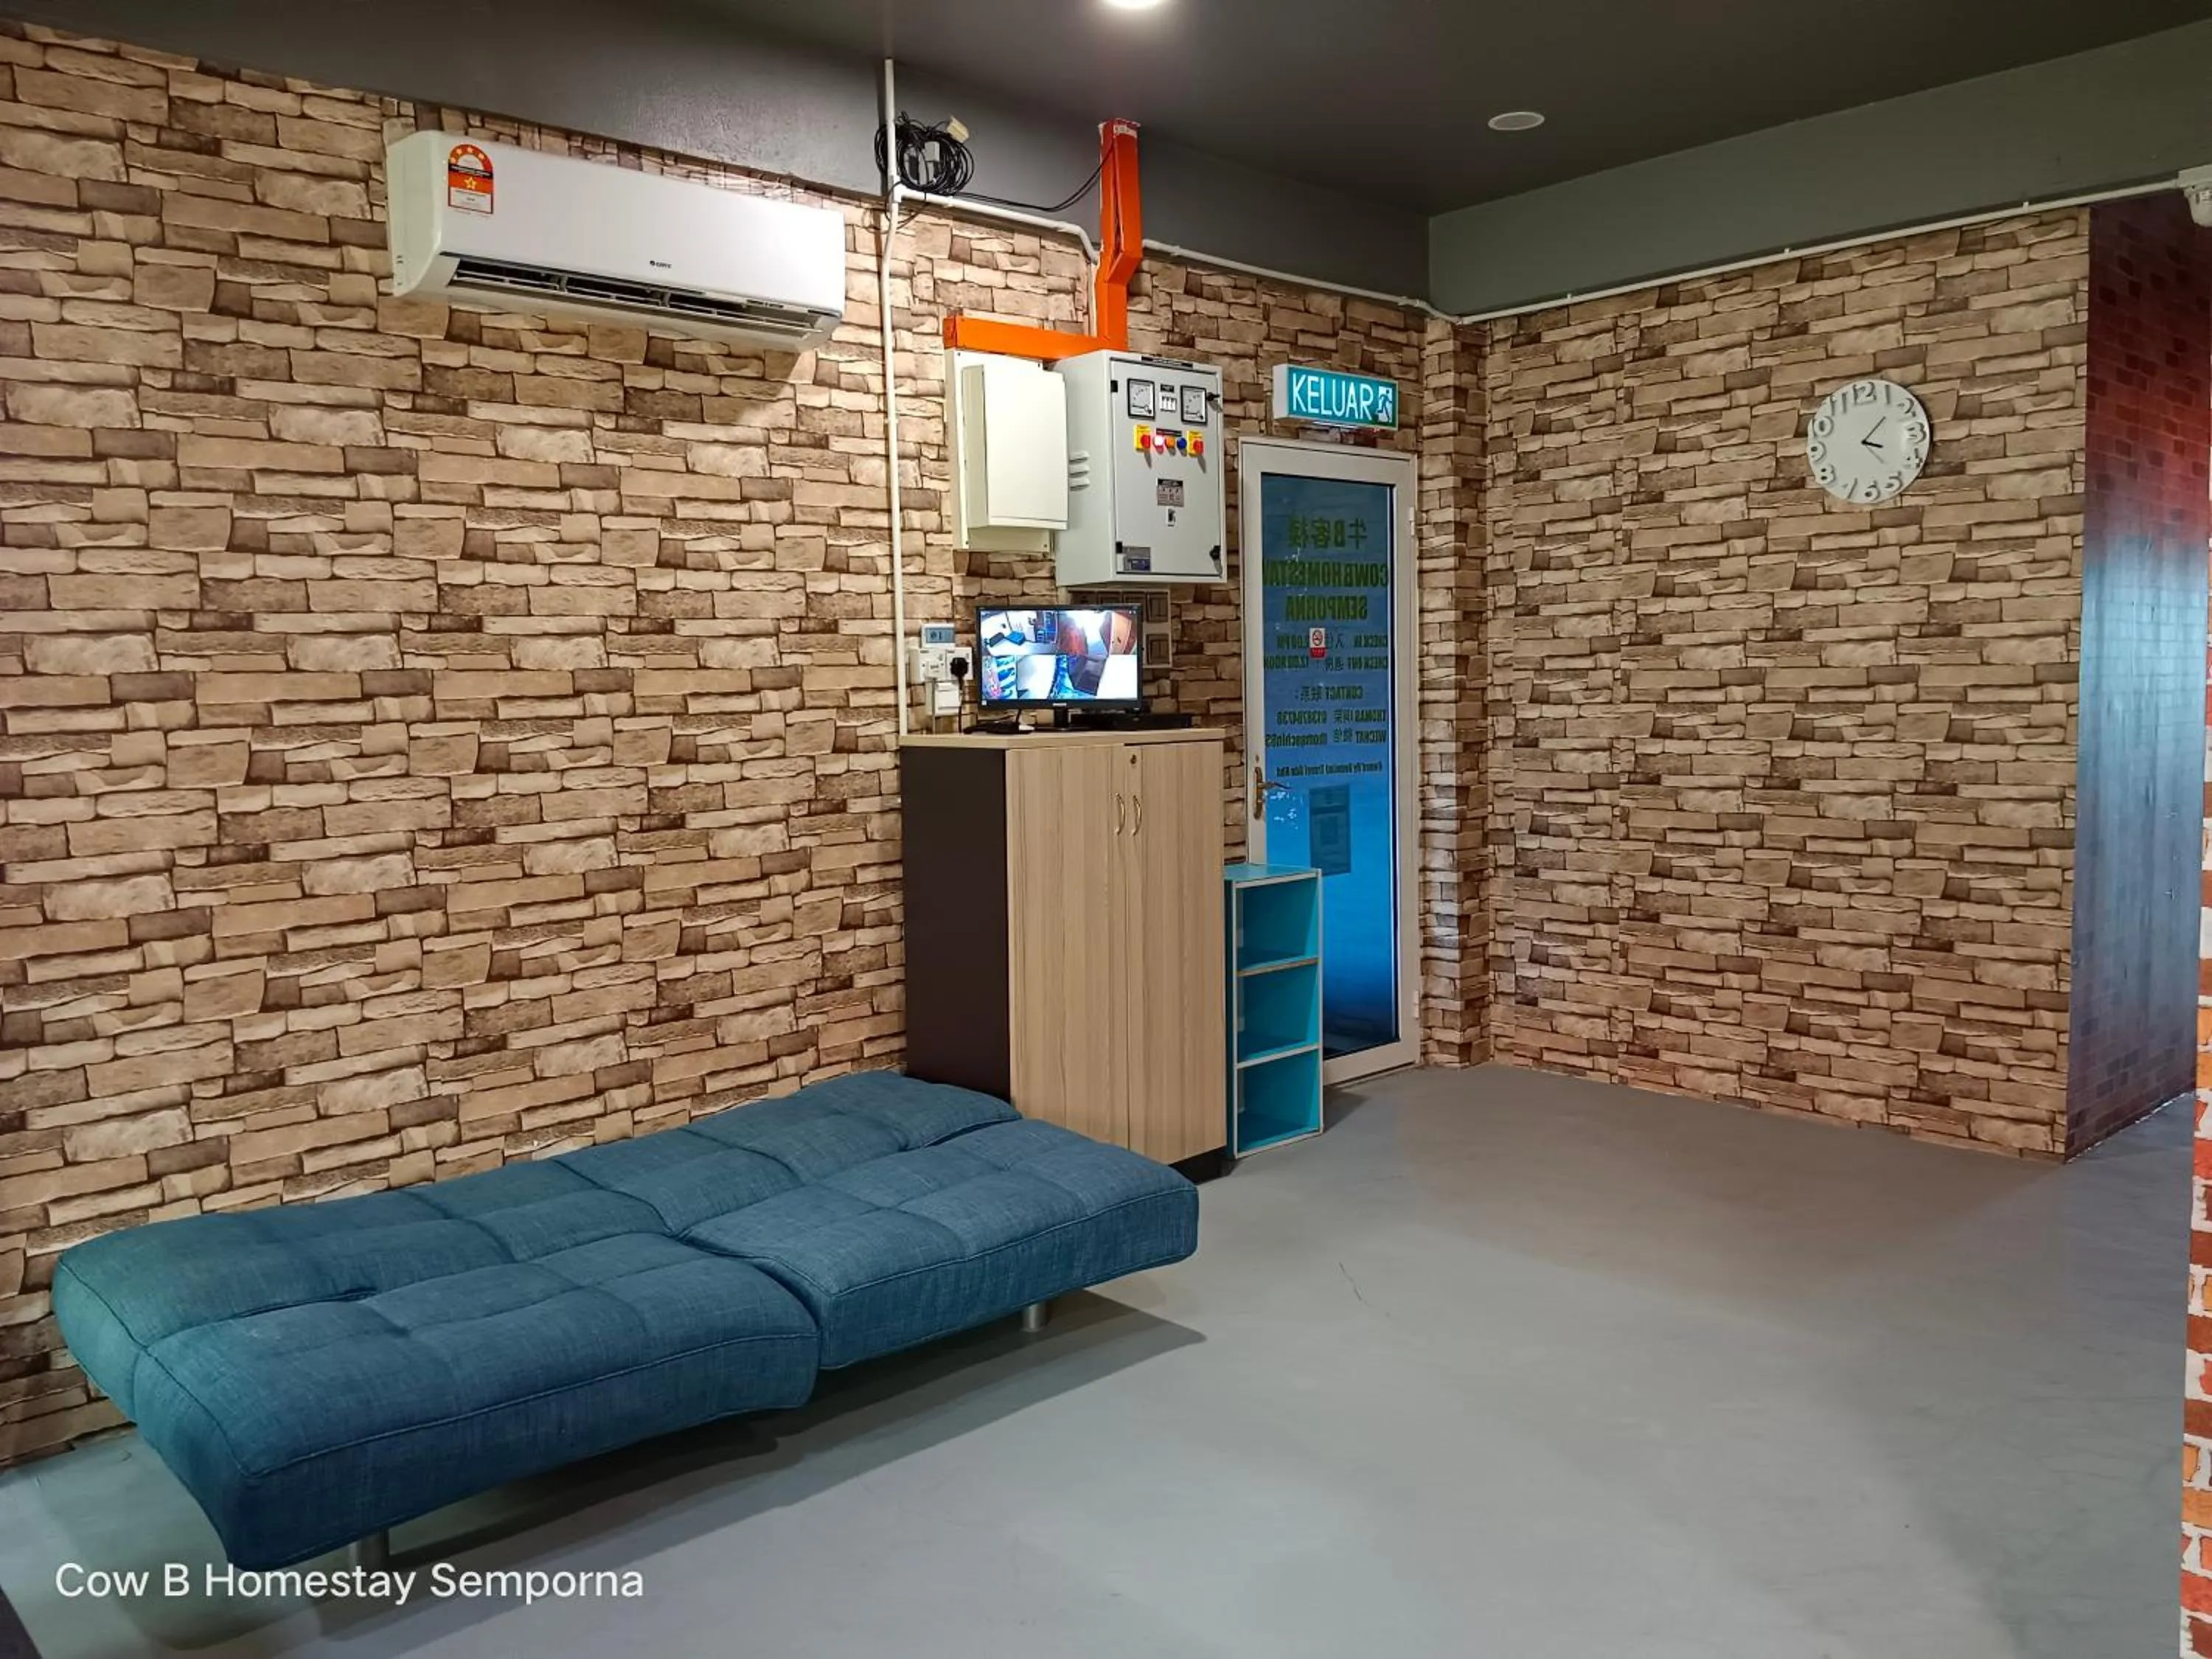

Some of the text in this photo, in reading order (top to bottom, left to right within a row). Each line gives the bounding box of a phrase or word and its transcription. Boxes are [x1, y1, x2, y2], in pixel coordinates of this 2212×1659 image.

[1292, 373, 1374, 420] KELUAR
[1852, 381, 1877, 404] 12
[1830, 392, 1847, 416] 11
[1812, 415, 1834, 437] 10
[1906, 421, 1927, 443] 3
[1809, 441, 1826, 462] 9
[1819, 463, 1836, 485] 8
[1885, 470, 1902, 493] 5
[1864, 480, 1881, 501] 6
